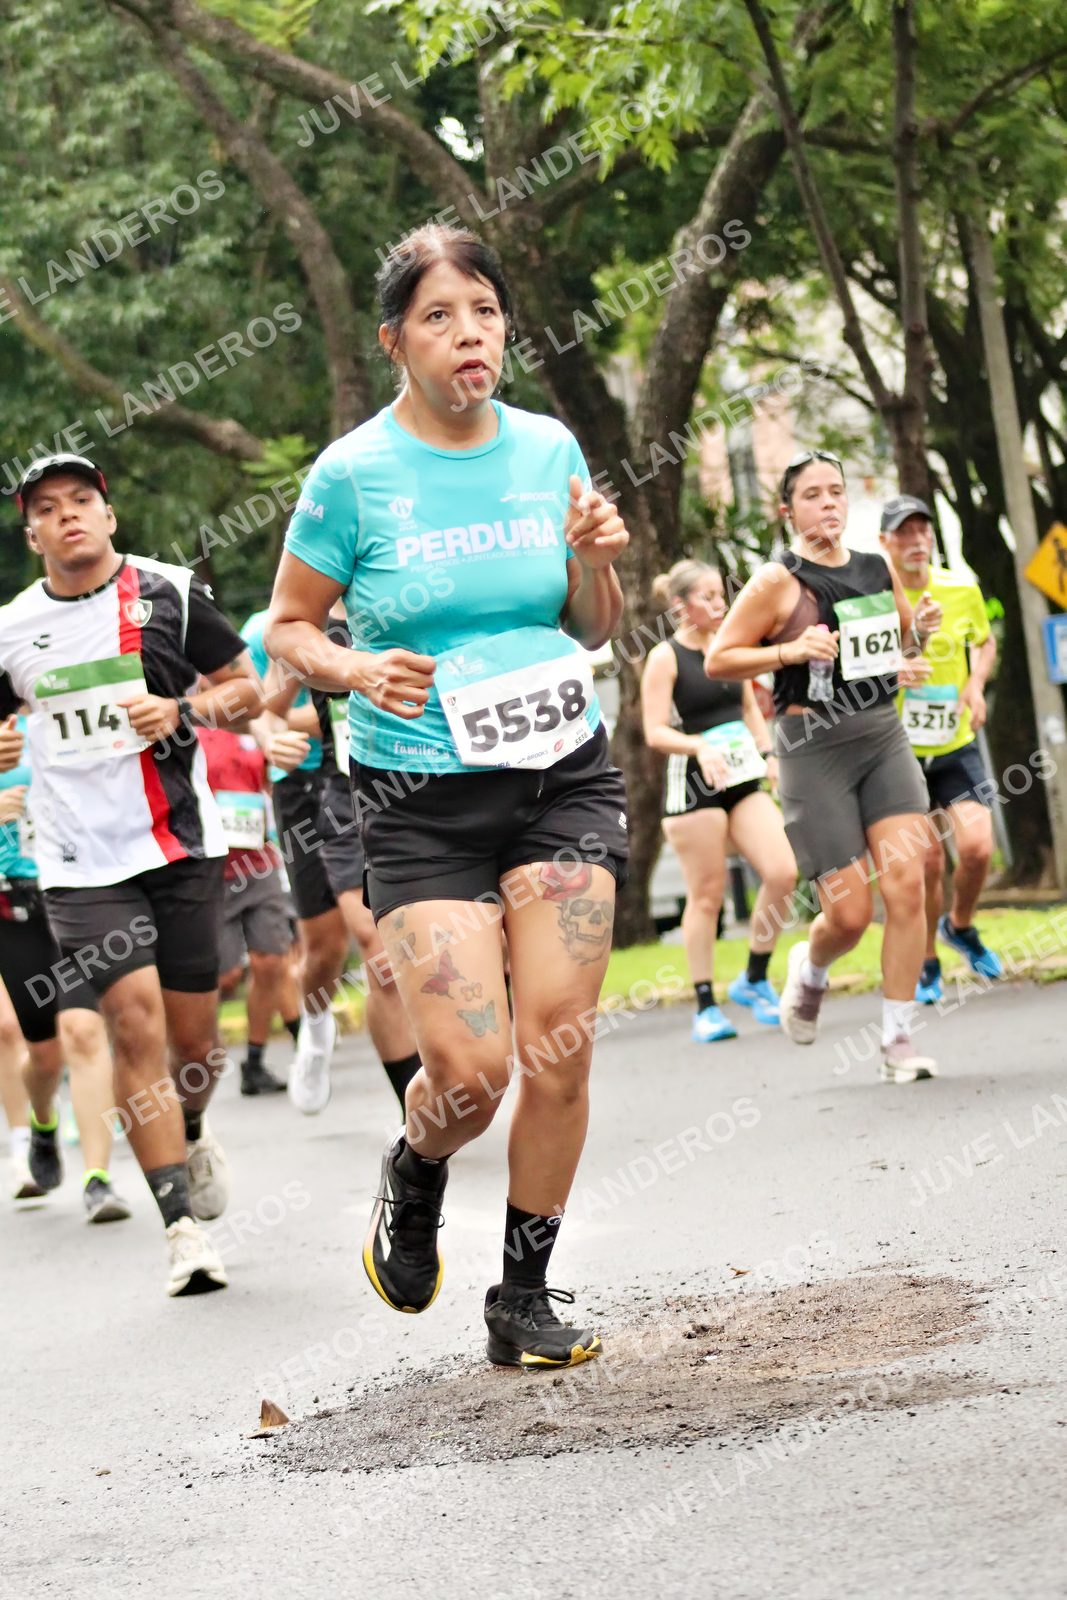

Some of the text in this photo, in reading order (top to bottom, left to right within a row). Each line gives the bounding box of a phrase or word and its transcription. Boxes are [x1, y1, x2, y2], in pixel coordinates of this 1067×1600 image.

[395, 518, 559, 568] PERDURA
[462, 678, 587, 753] 5538
[908, 710, 957, 731] 3215
